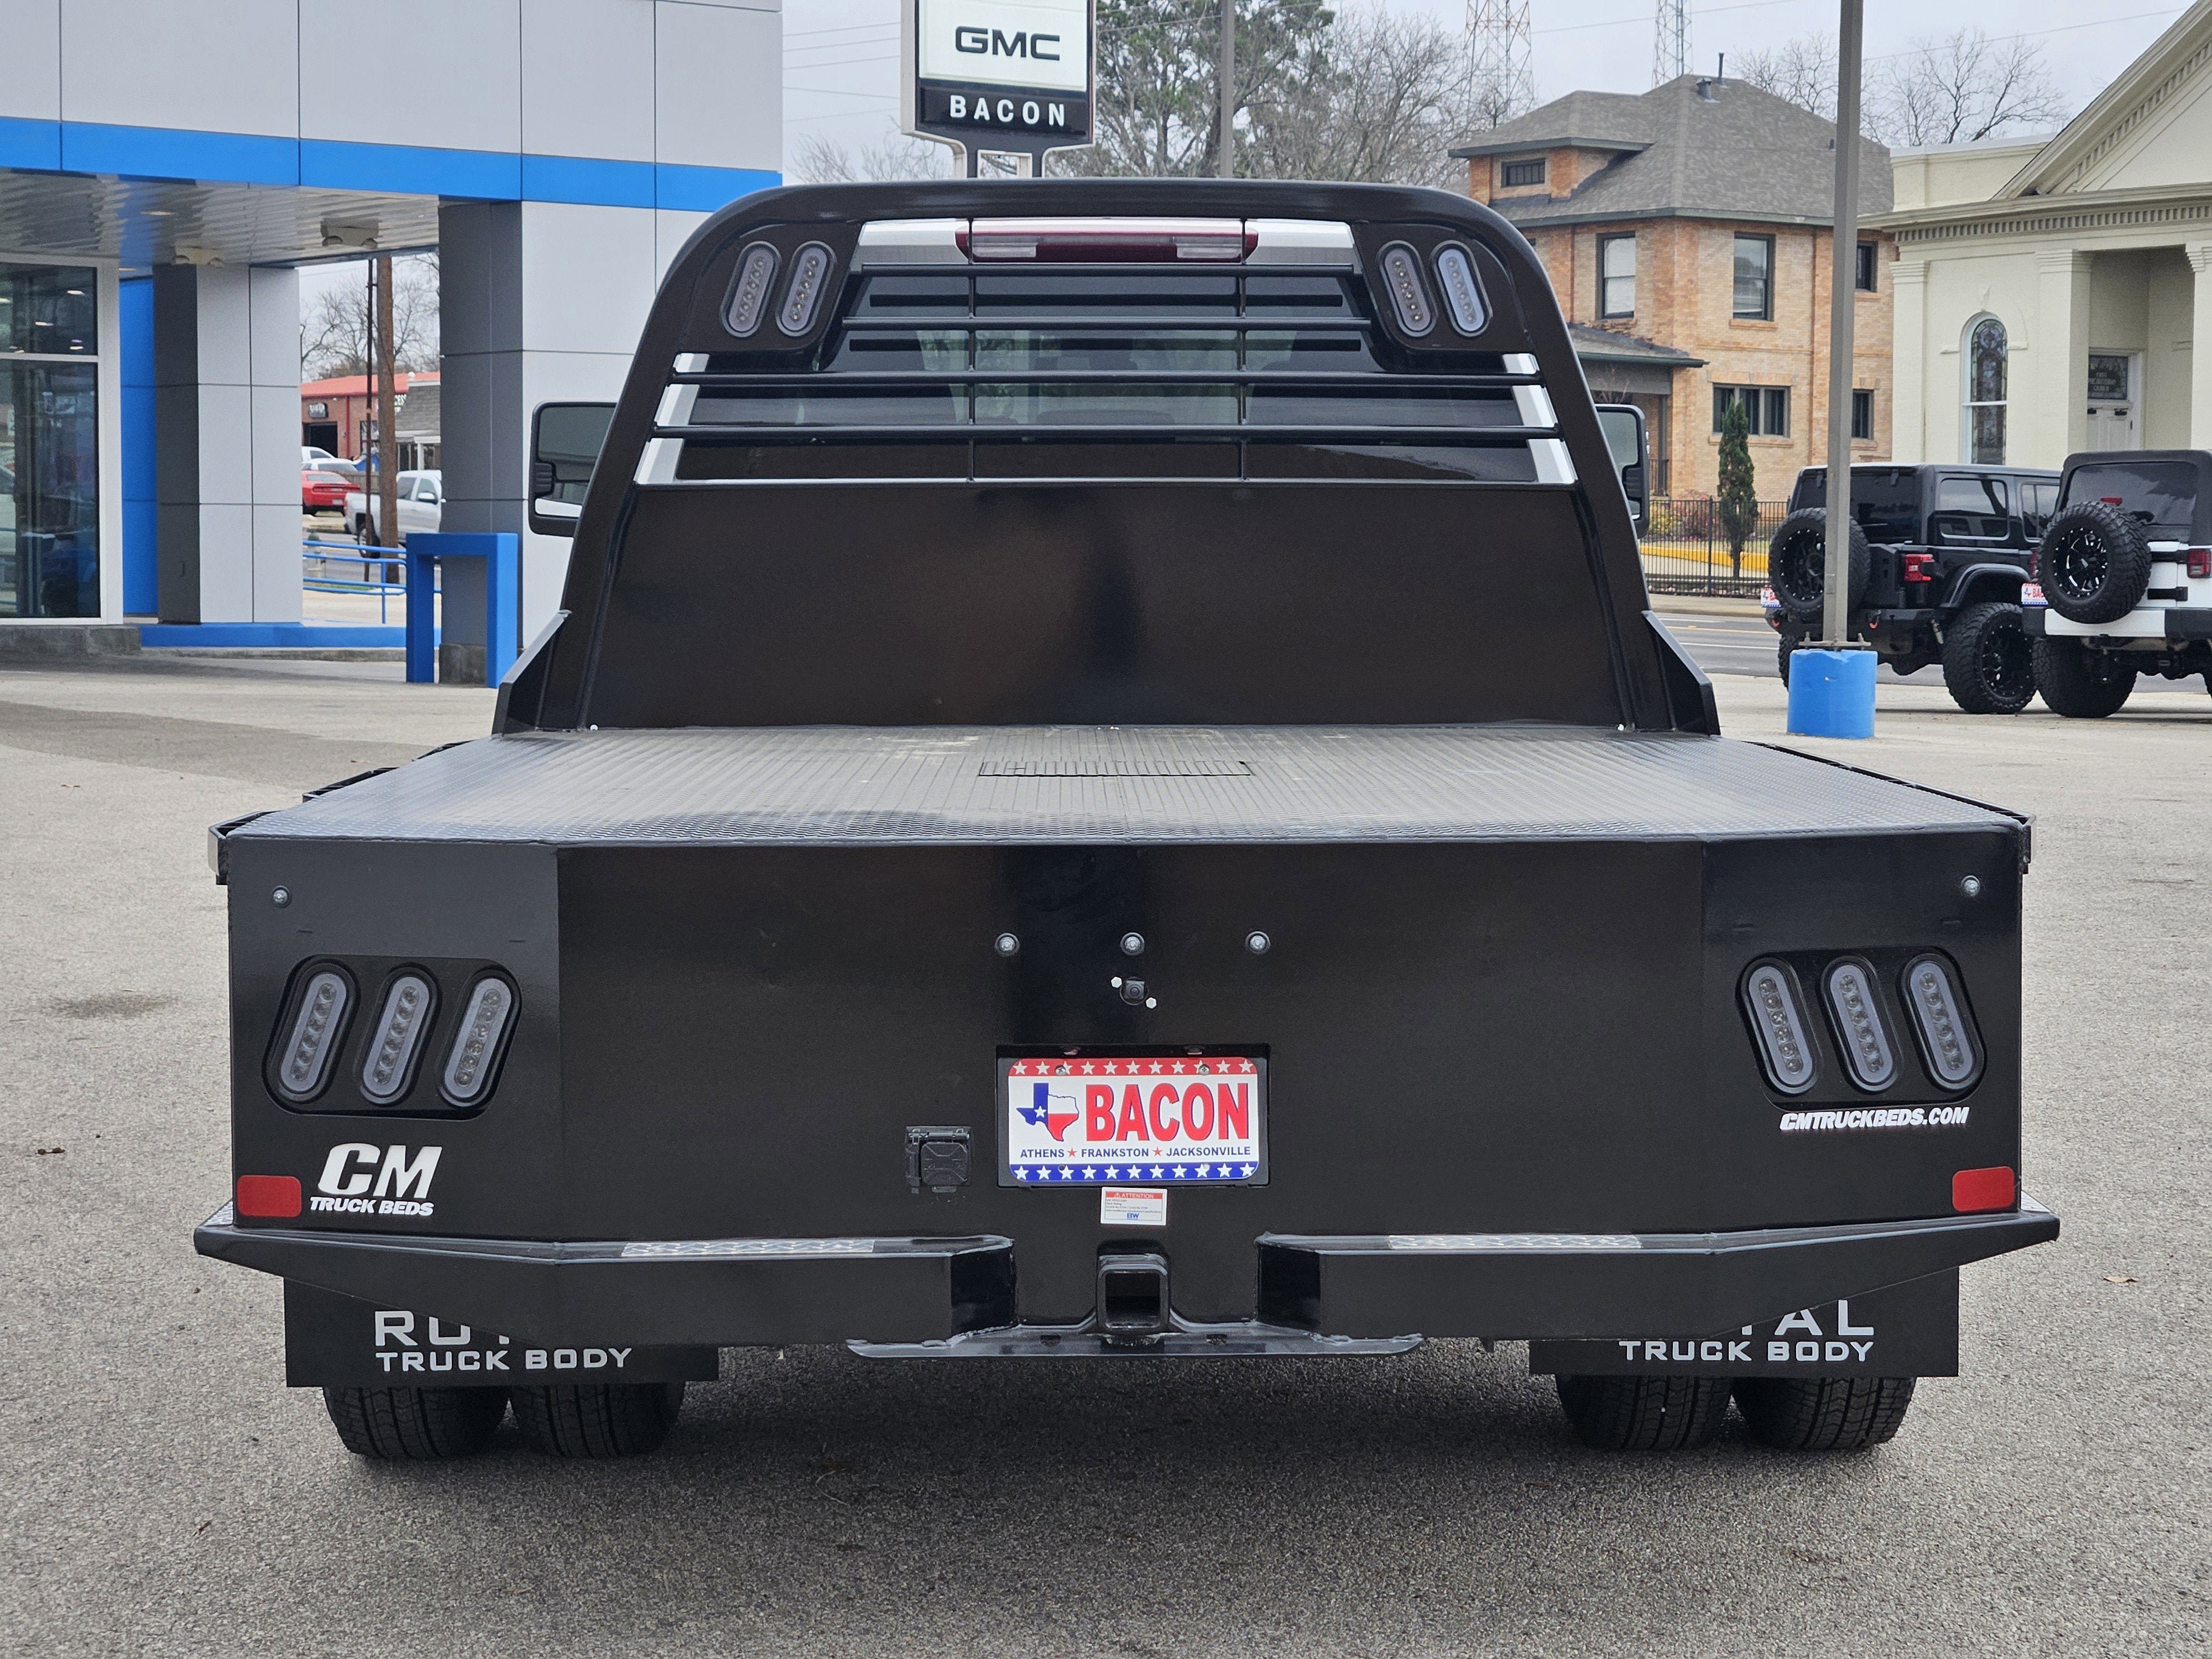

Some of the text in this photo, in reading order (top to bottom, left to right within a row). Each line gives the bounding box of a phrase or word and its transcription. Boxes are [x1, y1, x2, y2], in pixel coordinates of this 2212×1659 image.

[956, 26, 1060, 61] GMC
[950, 95, 1064, 126] BACON
[1086, 1082, 1249, 1141] BACON
[1779, 1107, 1970, 1130] CMTRUCKBEDS.COM
[1020, 1146, 1251, 1158] ATHENS FRANKSTON JACKSONVILLE
[317, 1143, 442, 1198] CM
[310, 1197, 435, 1216] TRUCK BEDS
[375, 1348, 632, 1371] TRUCK BODY
[1619, 1341, 1875, 1362] TRUCK BODY
